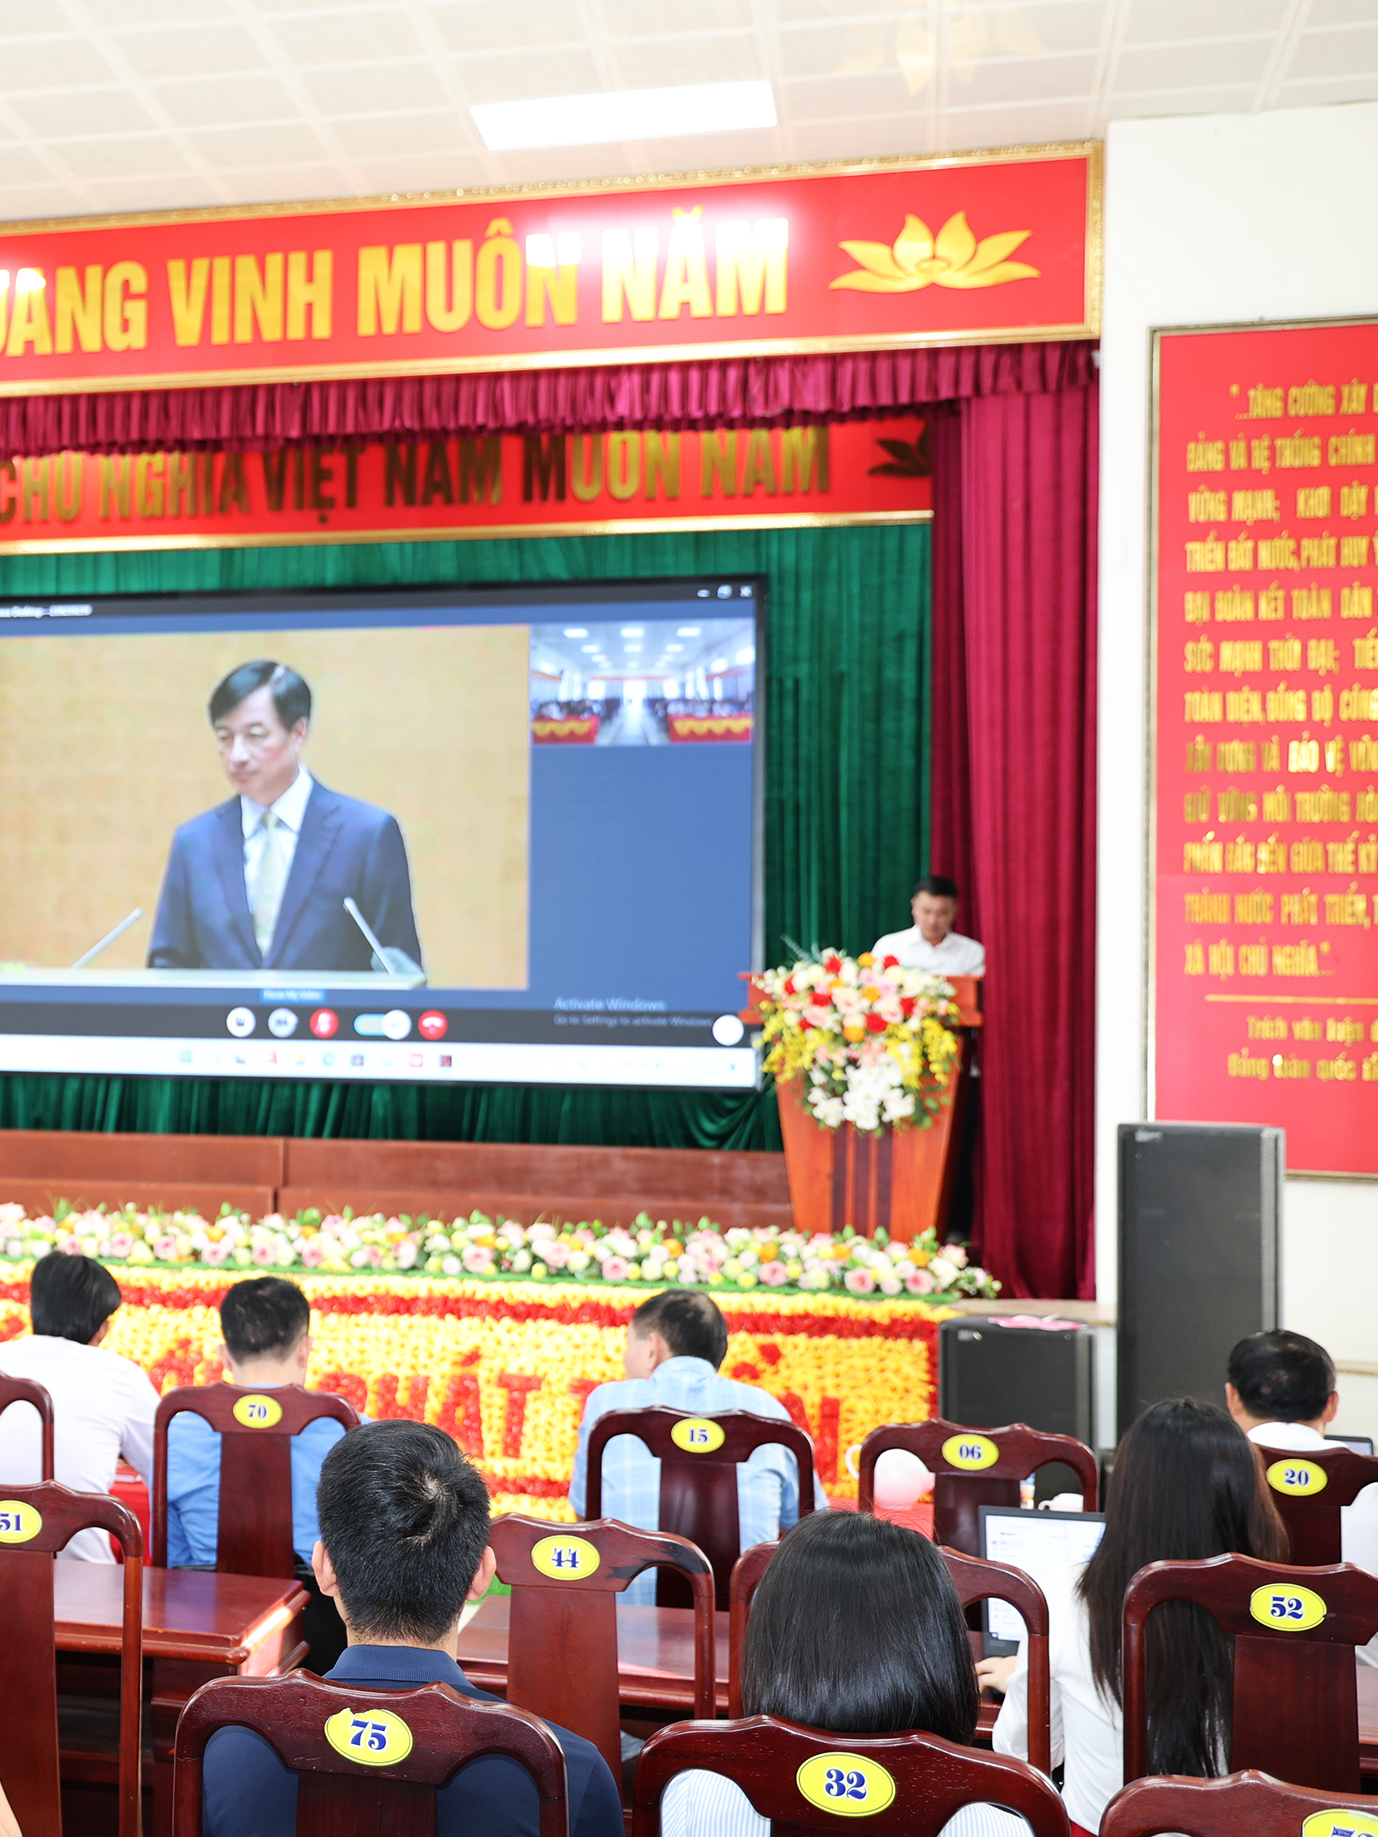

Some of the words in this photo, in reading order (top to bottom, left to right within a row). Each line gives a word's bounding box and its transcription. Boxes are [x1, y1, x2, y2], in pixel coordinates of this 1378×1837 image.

[167, 249, 332, 347] VINH
[357, 217, 582, 337] MUÔN
[602, 204, 789, 324] NĂM
[385, 439, 502, 506] NAM
[553, 996, 604, 1011] Activate
[606, 997, 667, 1012] Windows
[248, 1404, 268, 1420] 70
[688, 1429, 709, 1445] 15
[958, 1444, 982, 1460] 06
[1285, 1469, 1310, 1487] 20
[551, 1547, 581, 1569] 44
[1270, 1595, 1304, 1620] 52
[350, 1719, 388, 1752] 75
[825, 1768, 868, 1800] 32
